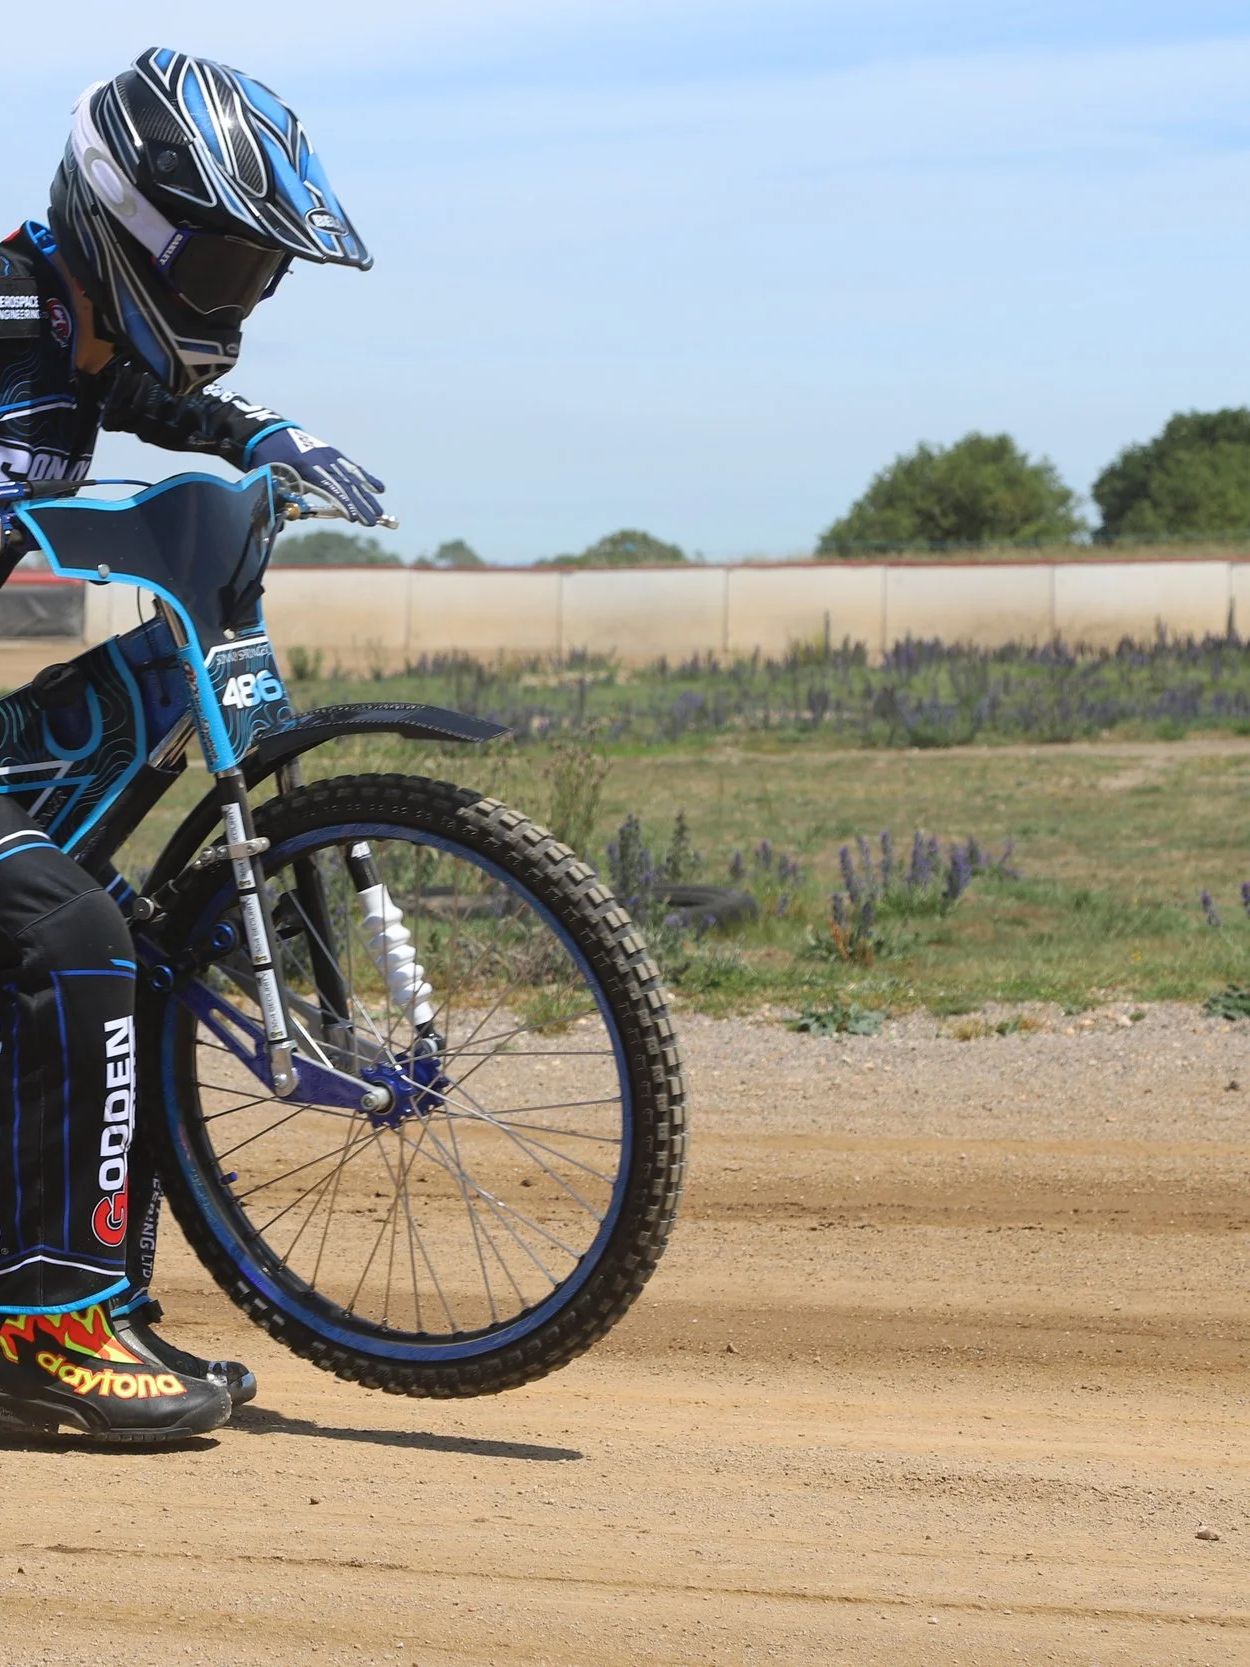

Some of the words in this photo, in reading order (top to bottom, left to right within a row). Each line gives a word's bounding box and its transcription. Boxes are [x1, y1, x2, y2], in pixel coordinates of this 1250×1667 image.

[222, 669, 283, 709] 486
[91, 1015, 133, 1247] GODDEN
[35, 1350, 188, 1399] daytona
